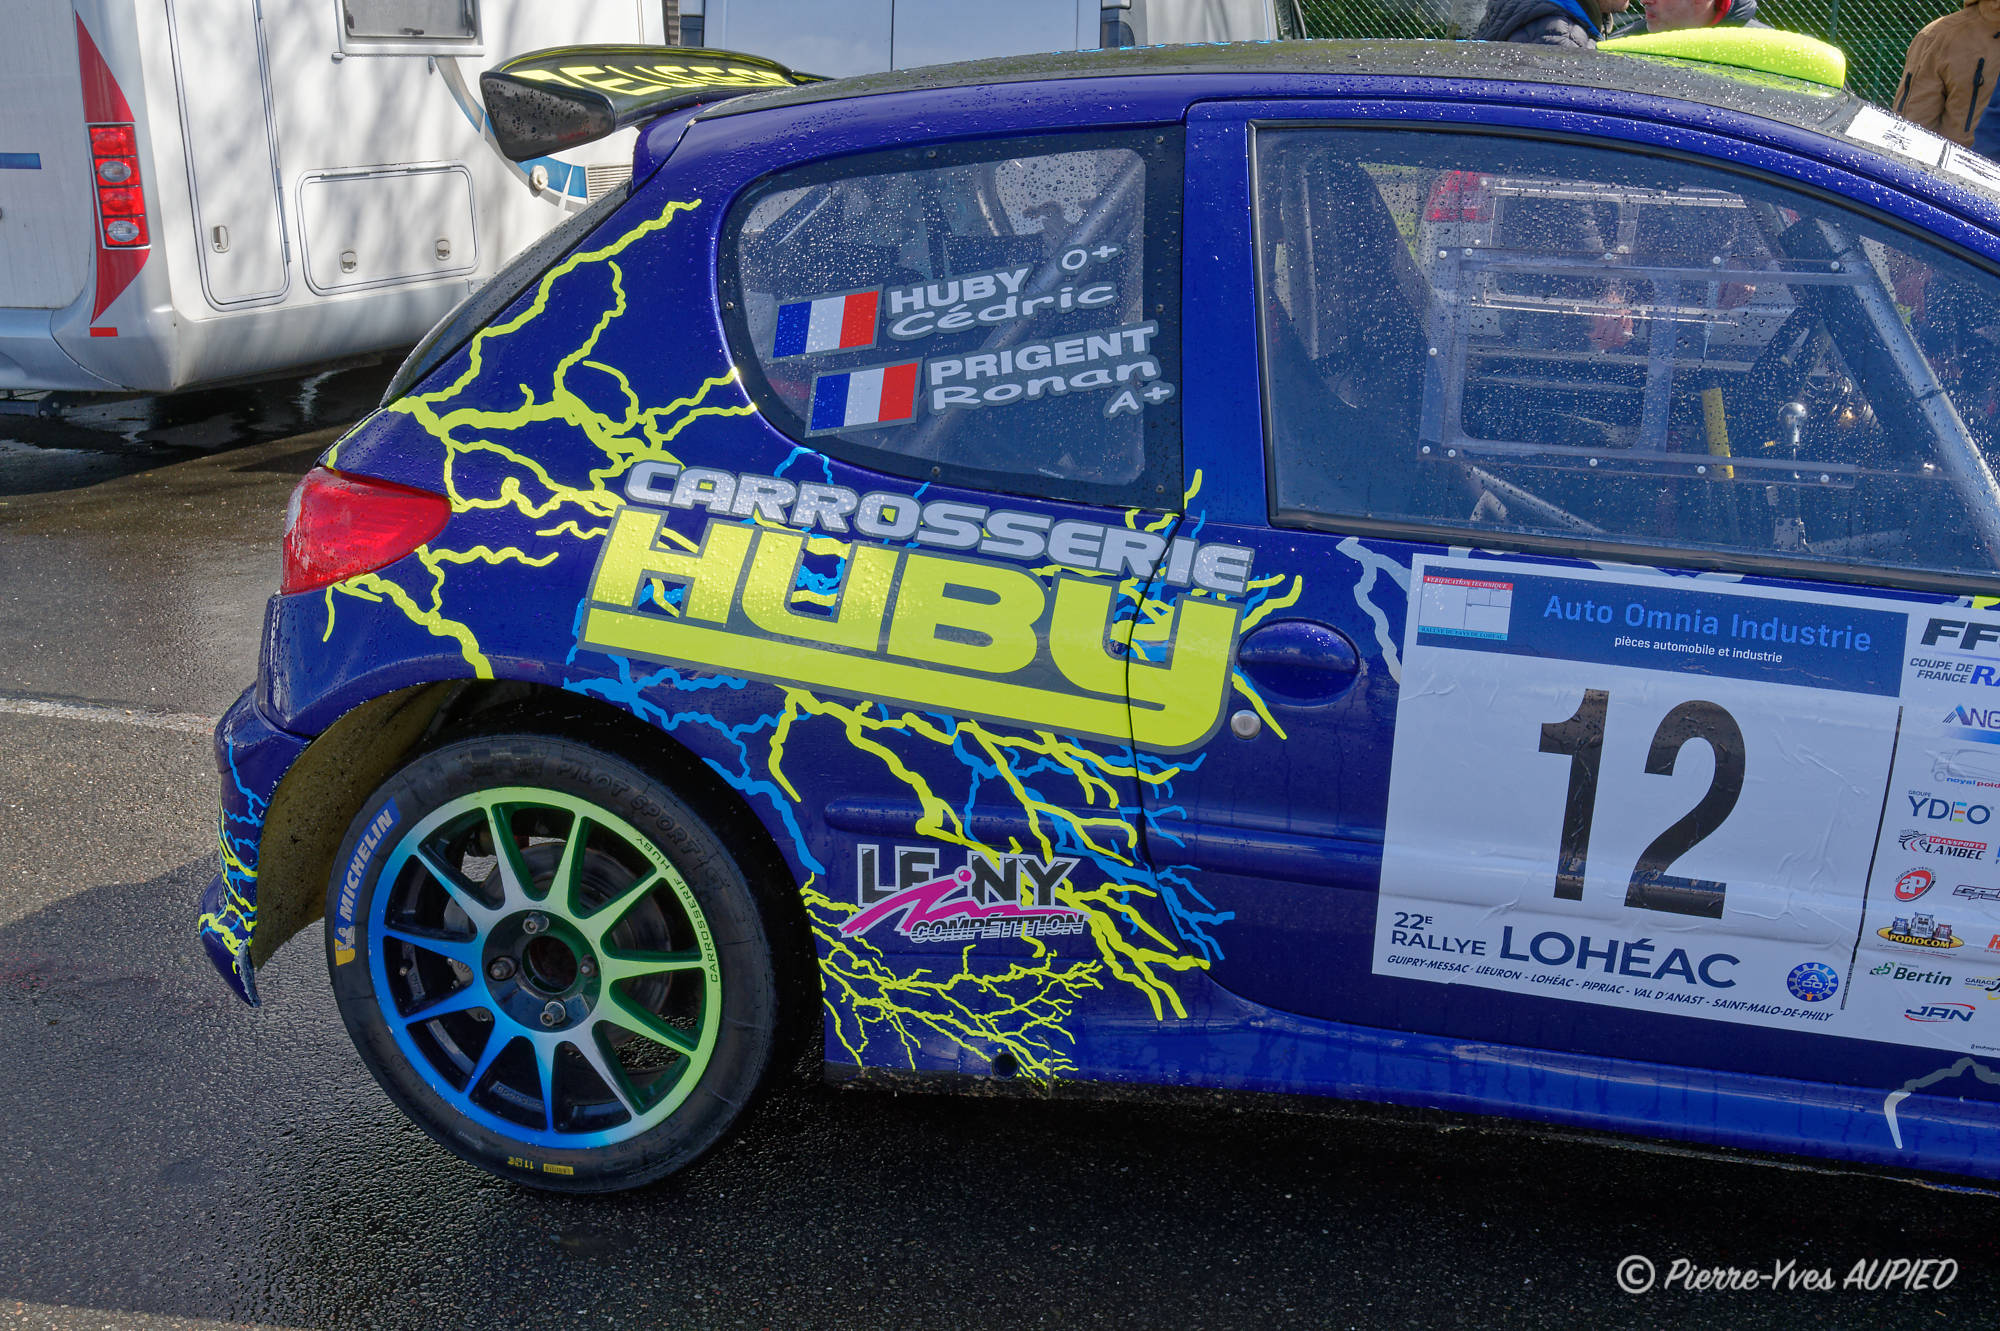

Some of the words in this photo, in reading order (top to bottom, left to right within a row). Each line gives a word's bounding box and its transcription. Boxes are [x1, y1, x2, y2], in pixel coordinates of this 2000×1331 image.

[890, 267, 1028, 314] HUBY
[892, 285, 1113, 336] Cédric
[931, 326, 1154, 385] PRIGENT
[933, 360, 1157, 410] Ronan
[1109, 386, 1170, 413] A+
[626, 462, 1255, 593] CARROSSERIE
[584, 506, 1239, 748] HUBY
[1544, 595, 1613, 624] Auto
[1625, 602, 1719, 635] Omnia
[1732, 613, 1871, 651] Industrie
[1614, 636, 1650, 649] pièces
[1653, 641, 1715, 655] automobile
[1718, 648, 1730, 657] et
[1732, 648, 1783, 663] industrie
[1910, 658, 1952, 670] COUPE
[1955, 663, 1974, 673] DE
[1917, 670, 1968, 683] FRANCE
[557, 759, 630, 797] PILOT
[1538, 688, 1746, 919] 12
[1908, 795, 1990, 825] YDEO
[630, 797, 706, 857] SPORT
[1932, 836, 1986, 850] TRANSPORTS
[339, 809, 394, 922] MICHELIN
[635, 837, 671, 870] HUBY
[1925, 843, 1985, 861] LAMBEC
[1391, 930, 1487, 956] RALLYE
[1500, 925, 1741, 989] LOHÉAC
[1889, 933, 1951, 949] PODIOCOM
[1387, 954, 1470, 974] GUIPRY-MESSAC
[1475, 965, 1522, 981] LIEURON
[1531, 973, 1574, 988] LOHÉAC
[1581, 980, 1625, 994] PIPRIAC
[1633, 987, 1652, 999] VAL
[1655, 991, 1706, 1006] D'ANAST
[1712, 998, 1834, 1022] SAINT-MALO-DE-PHILY
[1893, 966, 1952, 986] Bertin
